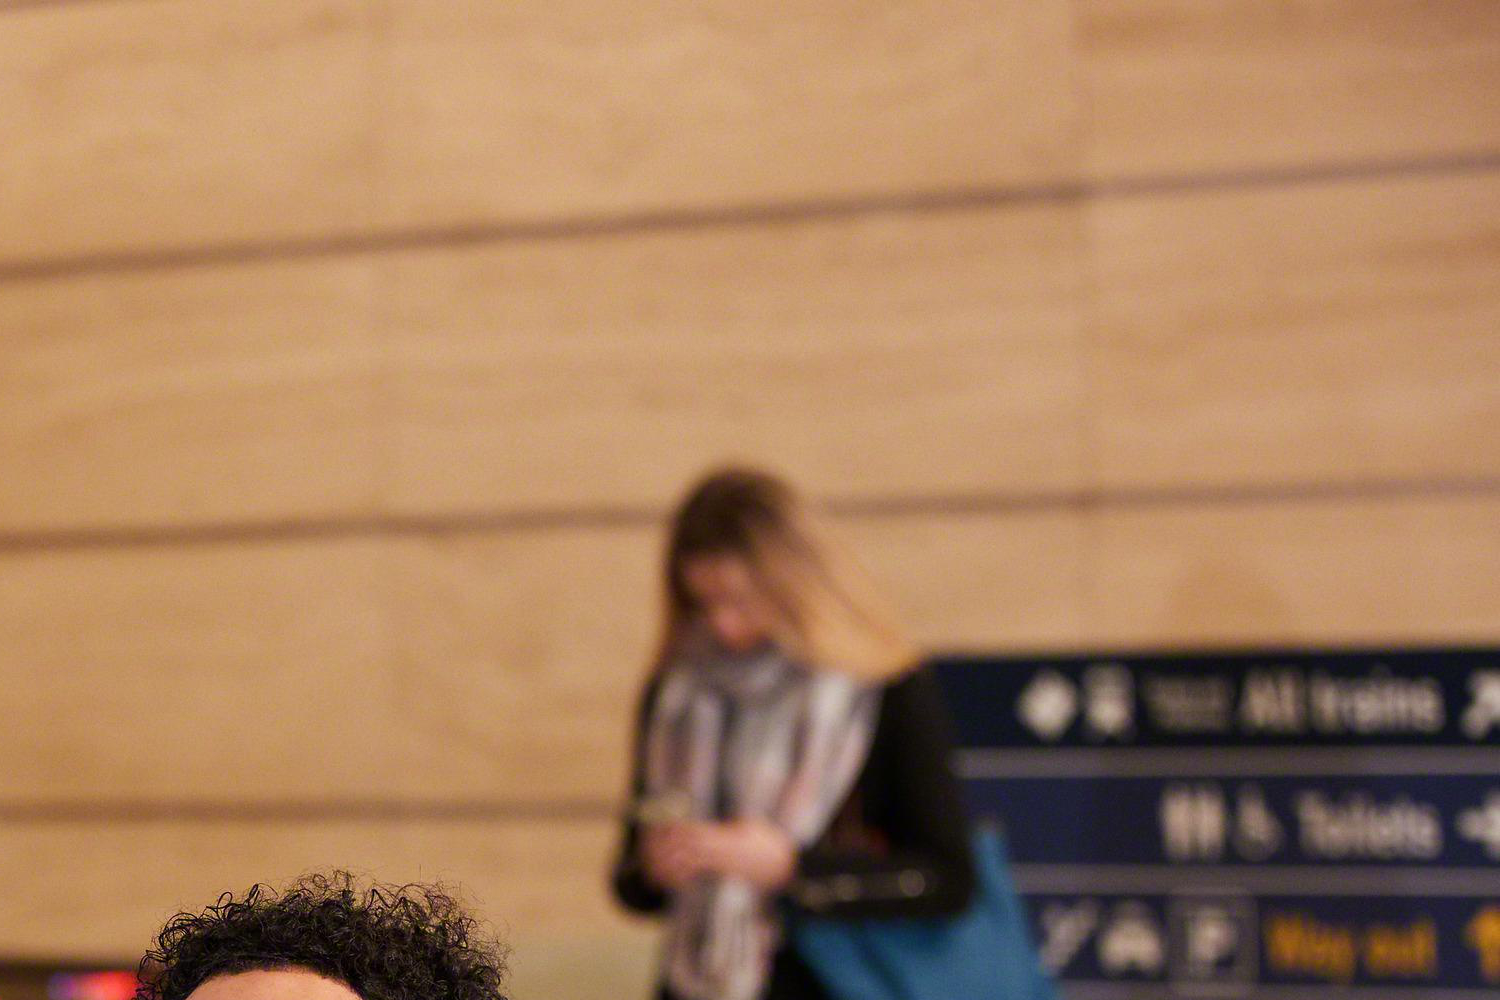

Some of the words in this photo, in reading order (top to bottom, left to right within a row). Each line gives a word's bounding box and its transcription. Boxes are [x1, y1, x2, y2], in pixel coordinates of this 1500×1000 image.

[1240, 670, 1301, 732] All
[1309, 668, 1444, 734] trains
[1297, 792, 1442, 859] Toilets
[1265, 911, 1356, 983] Way
[1365, 918, 1437, 977] out
